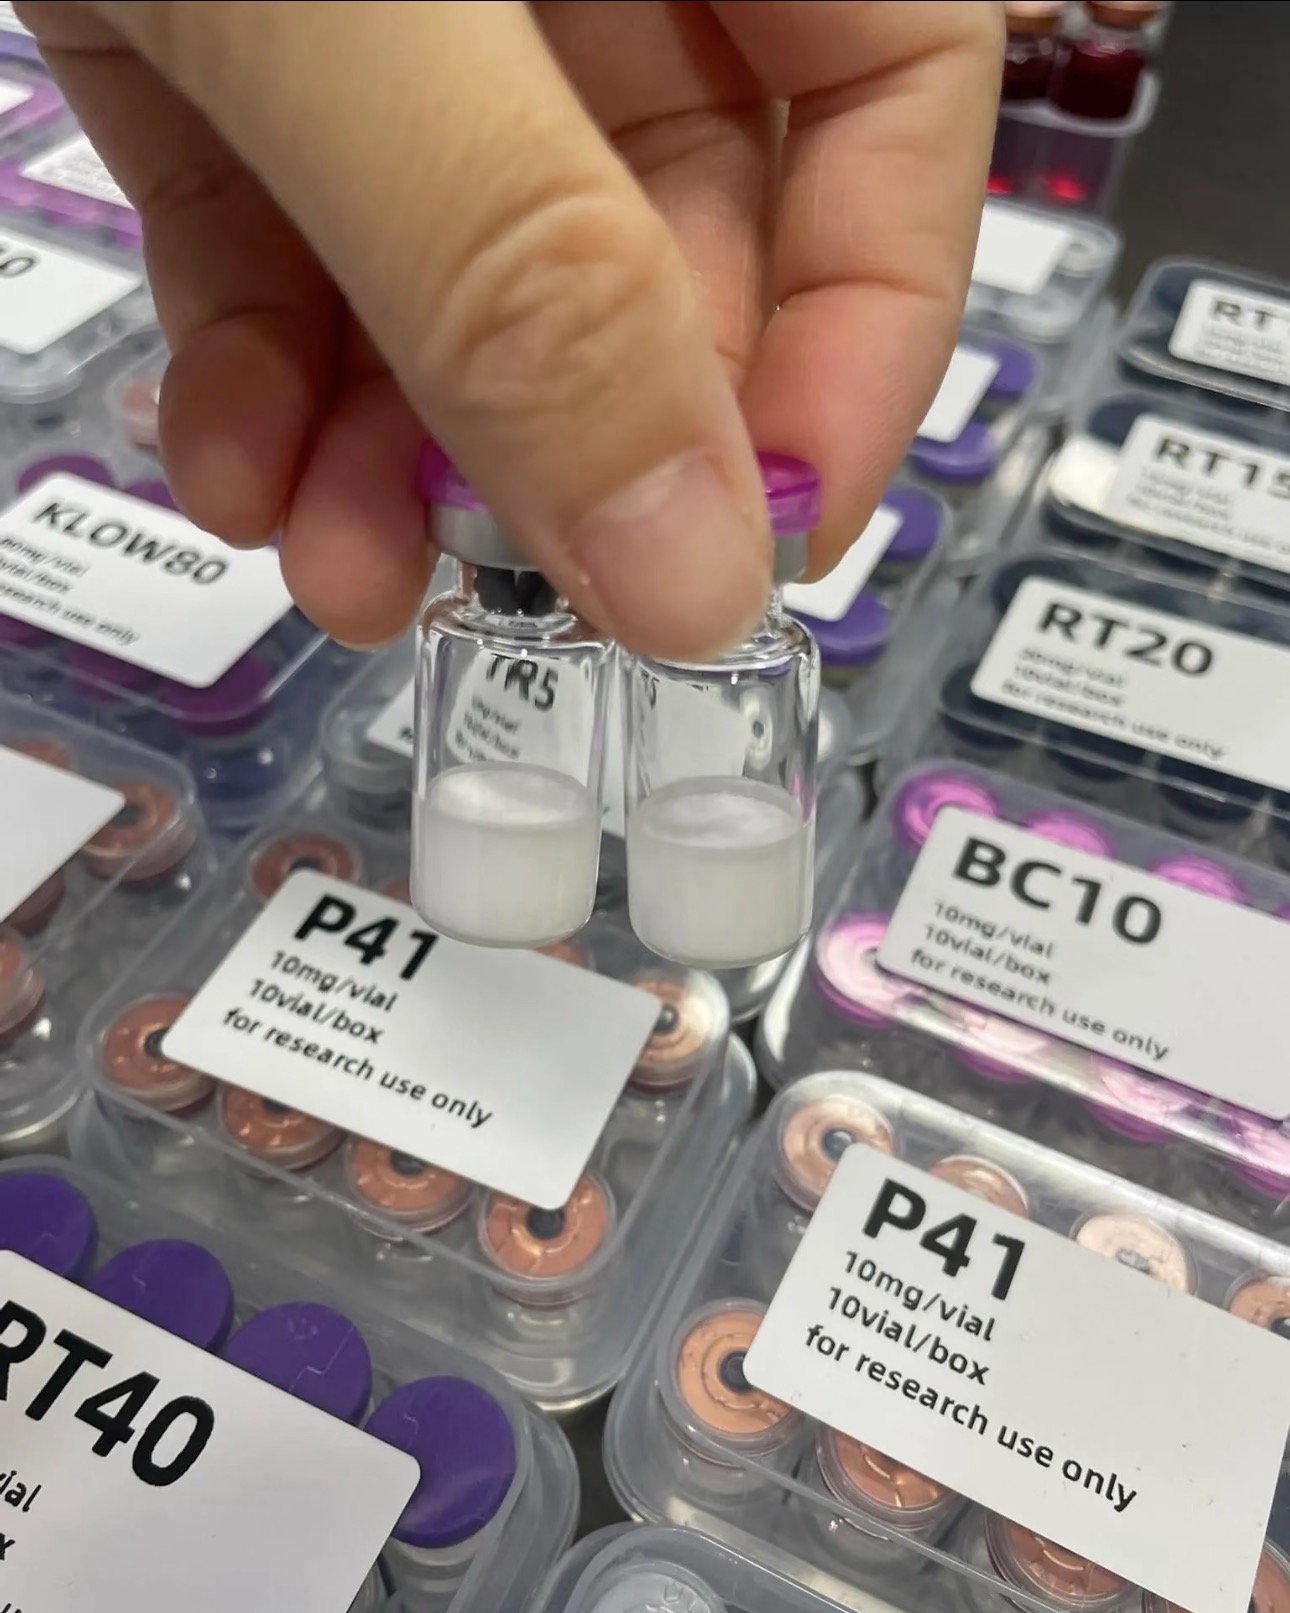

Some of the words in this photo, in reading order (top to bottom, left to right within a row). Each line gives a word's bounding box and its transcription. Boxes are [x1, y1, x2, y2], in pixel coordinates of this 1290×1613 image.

[33, 500, 229, 585] KLOW80
[1039, 601, 1213, 677] RT20
[1131, 722, 1168, 742] use
[1174, 734, 1225, 760] only
[936, 901, 1055, 959] 10mg/vial
[953, 837, 1162, 946] BC10
[271, 951, 399, 1012] 10mg/vial
[293, 894, 439, 981] P41
[925, 925, 1052, 986] 10vial/box
[250, 979, 384, 1044] 10vial/box
[910, 949, 946, 972] for
[950, 965, 1055, 1016] research
[1062, 1007, 1106, 1037] use
[1113, 1026, 1170, 1062] only
[223, 1007, 262, 1035] for
[264, 1025, 374, 1081] research
[379, 1070, 427, 1101] use
[431, 1092, 493, 1130] only
[862, 1178, 1025, 1301] P41
[828, 1287, 991, 1386] 10vial/box
[844, 1251, 996, 1342] 10mg/vial
[0, 1300, 215, 1487] RT40
[805, 1325, 850, 1361] for
[855, 1354, 989, 1435] research
[997, 1425, 1055, 1468] use
[1062, 1458, 1137, 1513] only
